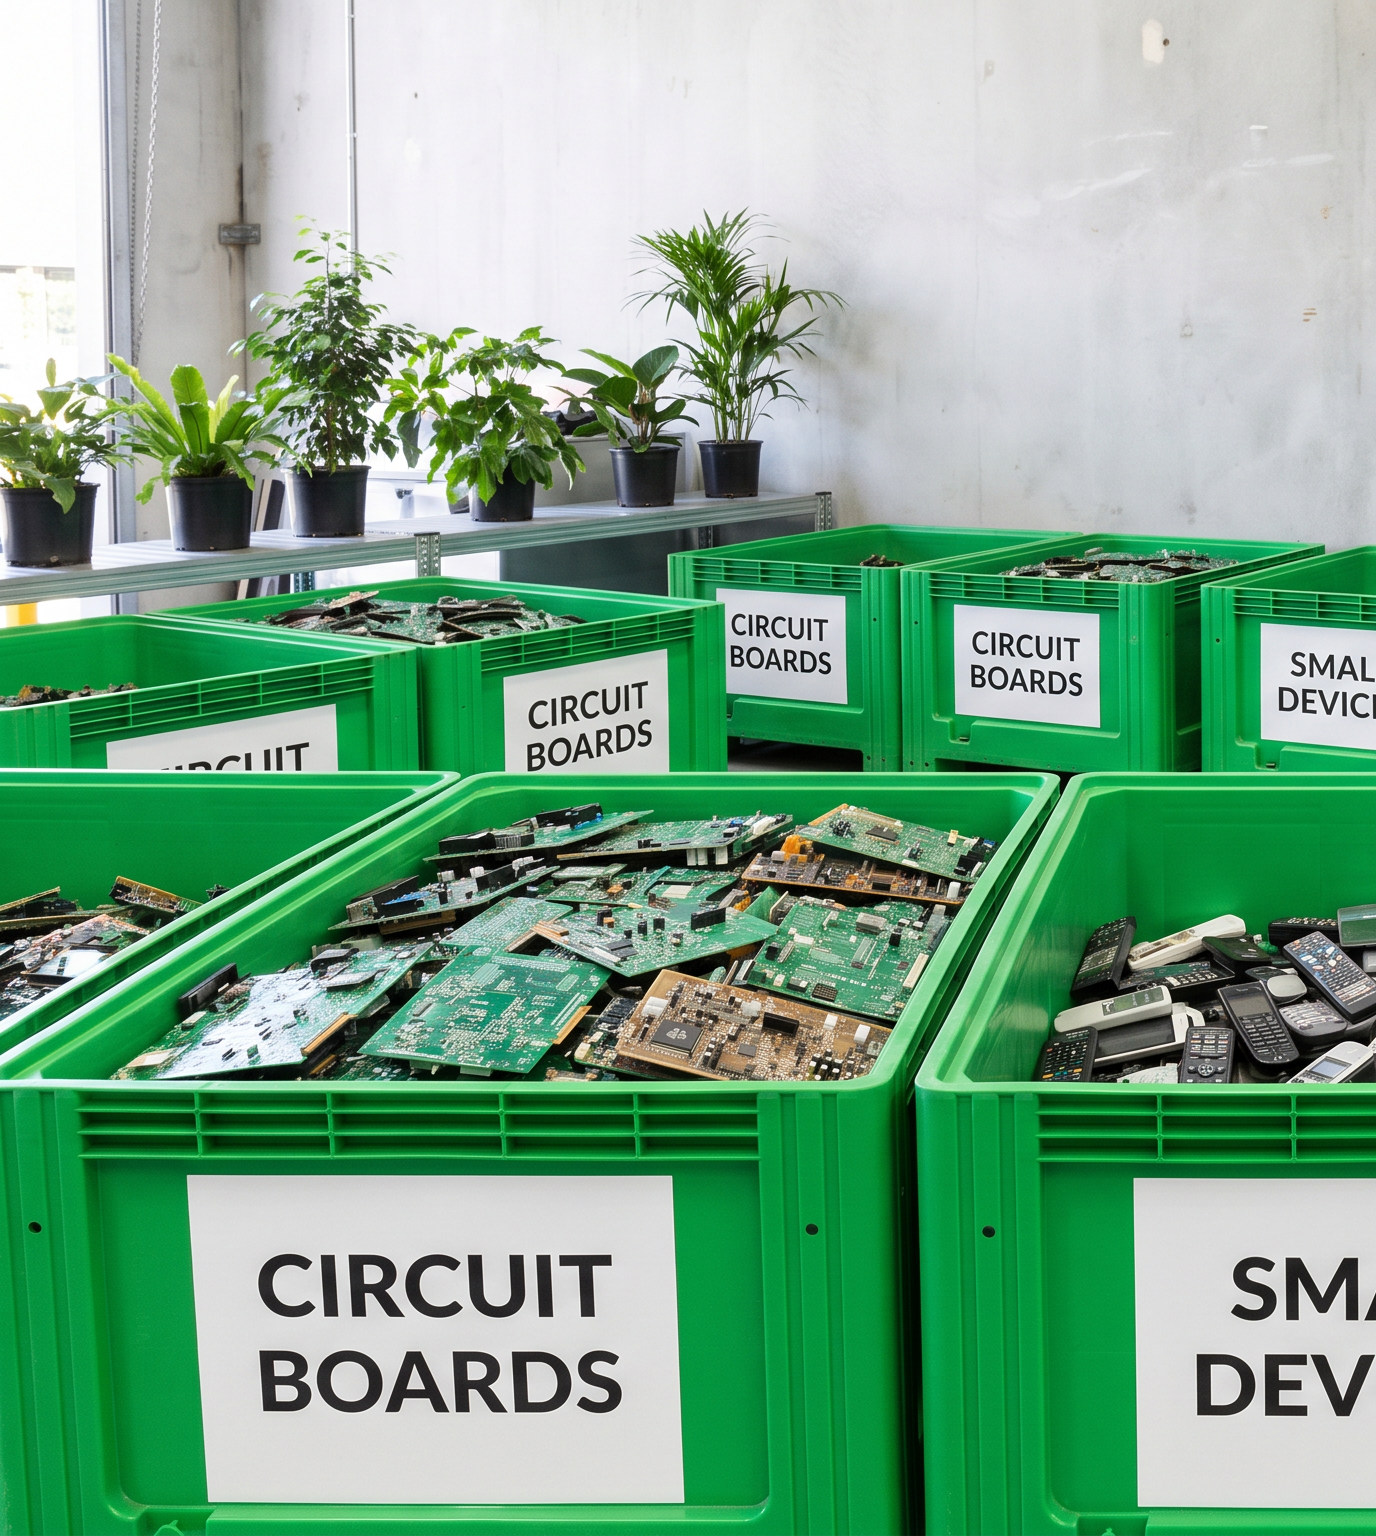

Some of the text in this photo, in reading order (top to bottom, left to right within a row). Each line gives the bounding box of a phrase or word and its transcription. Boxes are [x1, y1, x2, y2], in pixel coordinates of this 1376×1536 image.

[731, 613, 829, 642] CIRCUIT
[971, 630, 1081, 662] CIRCUIT
[730, 644, 832, 675] BOARDS
[970, 664, 1083, 697] BOARDS
[528, 680, 649, 730] CIRCUIT
[526, 719, 653, 772] BOARDS
[257, 1253, 613, 1319] CIRCUIT
[258, 1350, 623, 1414] BOARDS
